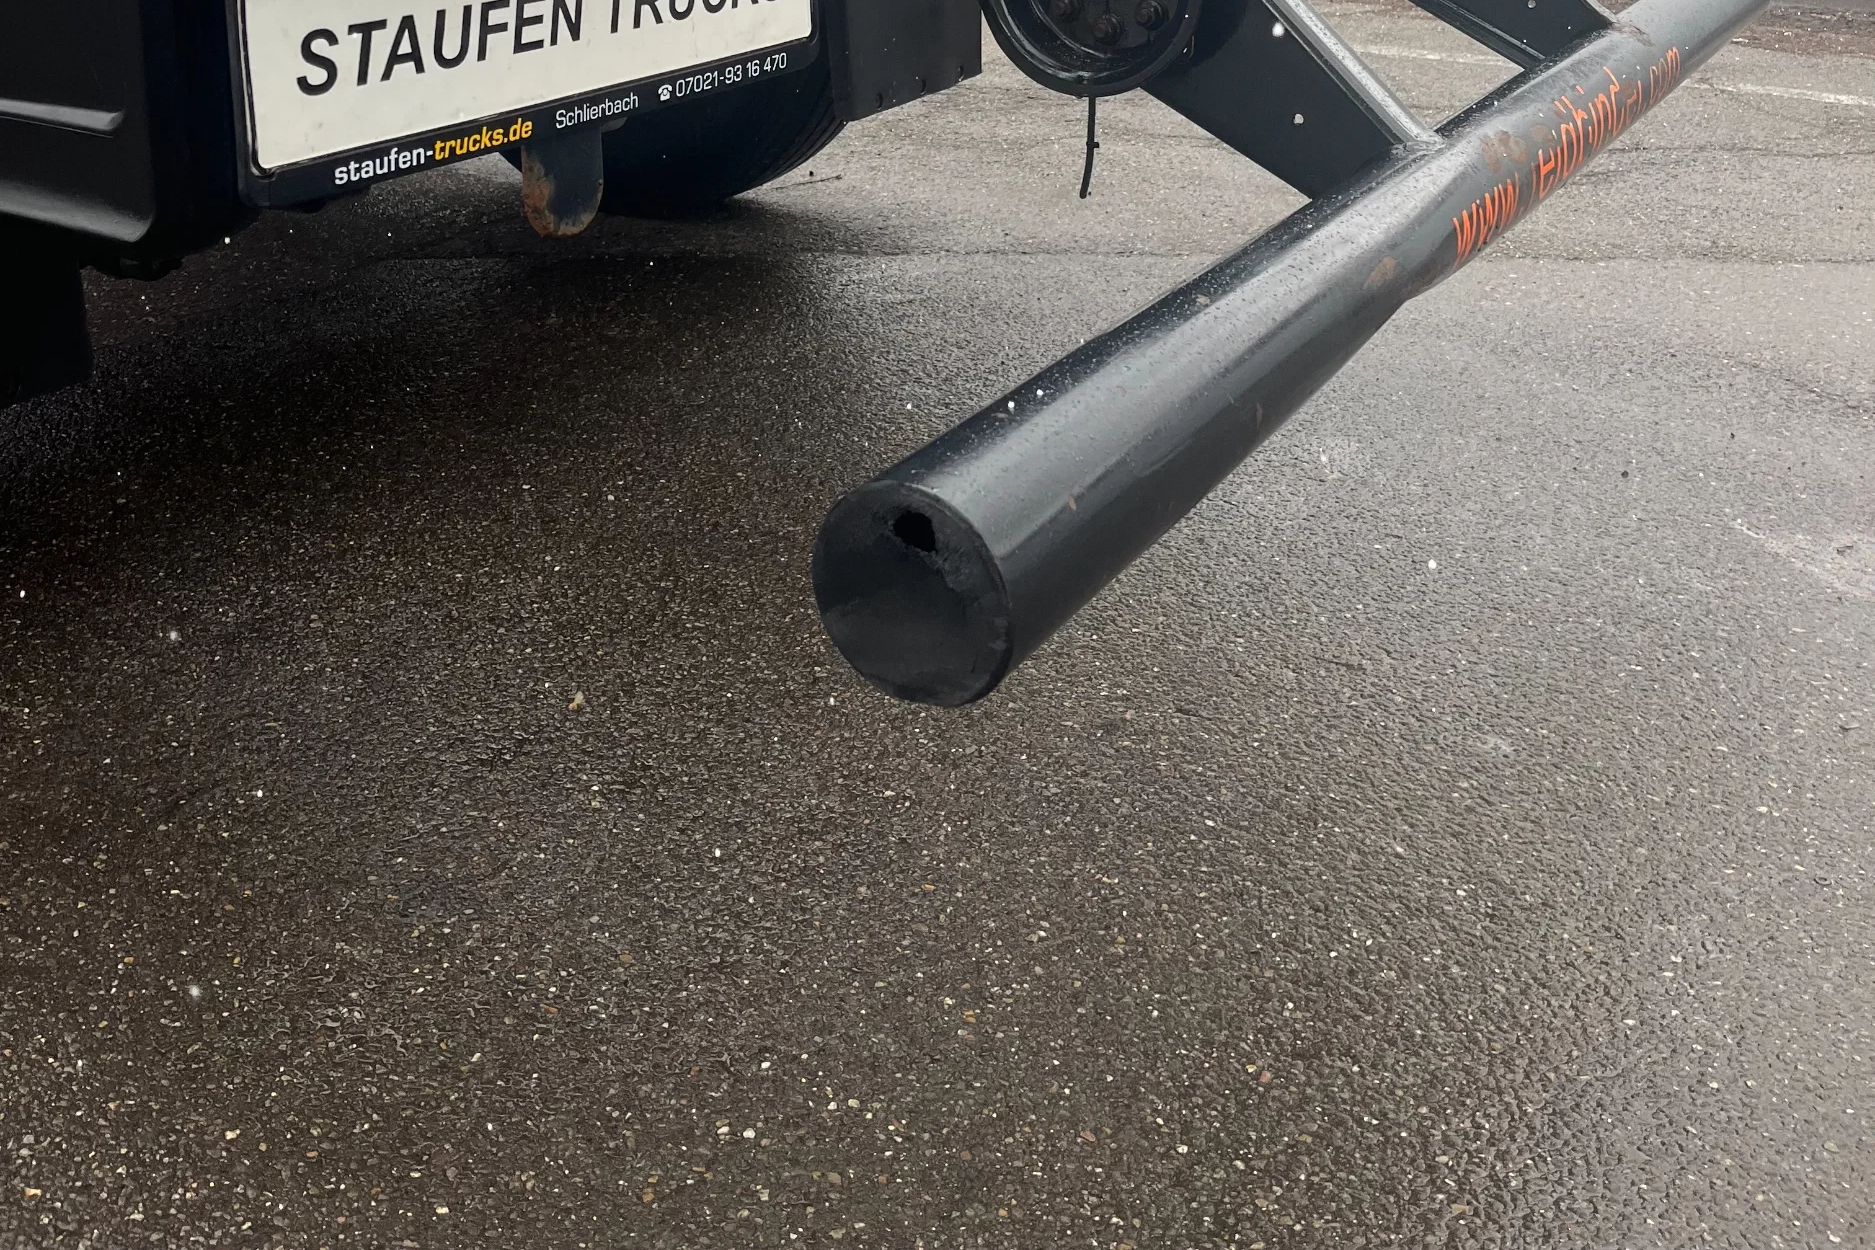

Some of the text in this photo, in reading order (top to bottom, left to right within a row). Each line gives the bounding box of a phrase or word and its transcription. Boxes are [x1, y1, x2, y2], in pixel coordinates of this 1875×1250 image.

[334, 52, 788, 186] staufen-trucks.de Schlierbach 07021-93 16 470
